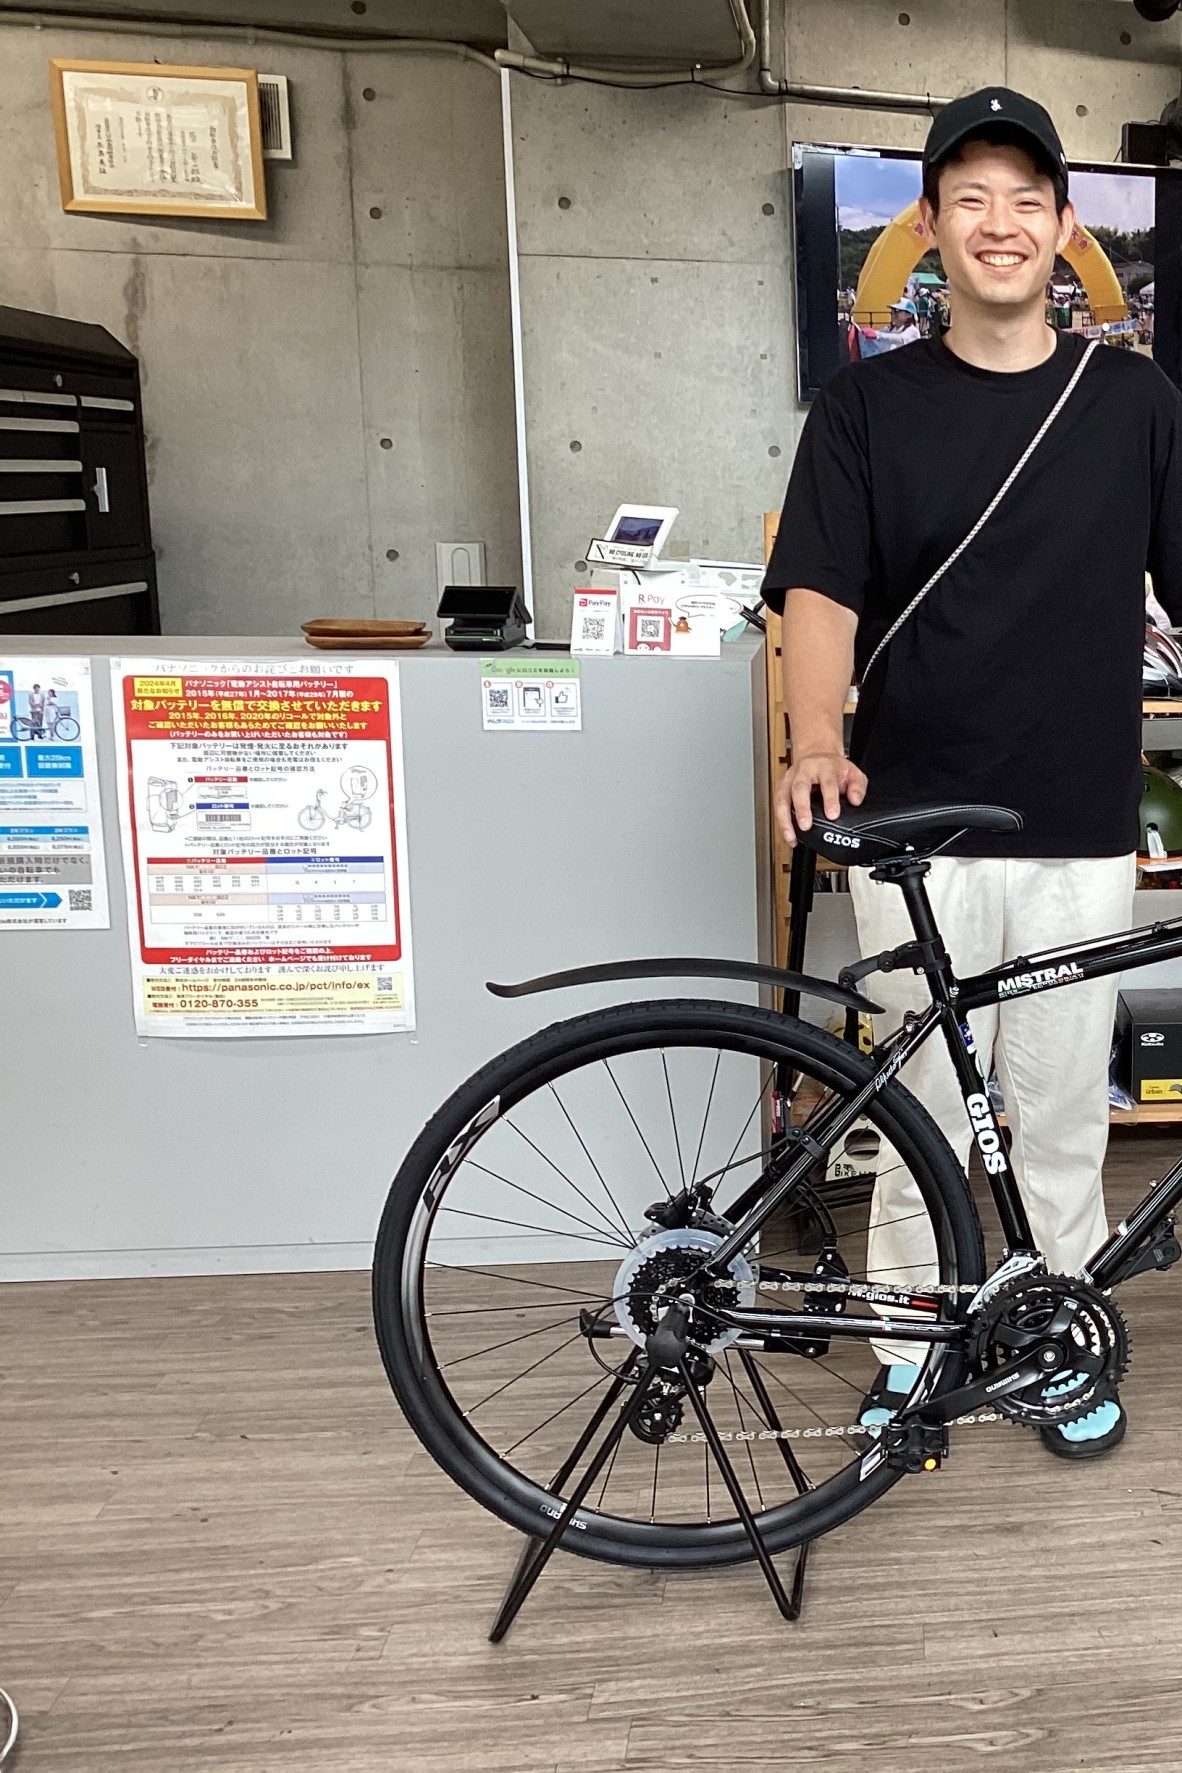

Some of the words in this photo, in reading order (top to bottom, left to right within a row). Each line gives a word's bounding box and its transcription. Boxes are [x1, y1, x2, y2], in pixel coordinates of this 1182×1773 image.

[648, 594, 665, 604] Pay
[823, 832, 860, 848] GIOS
[182, 981, 370, 992] https://panasonic.co.jp/pct/info/ex
[997, 962, 1083, 993] MISTRAL
[180, 999, 258, 1008] 0120-870-355
[967, 1093, 1007, 1174] GIOS
[986, 1372, 1020, 1393] SHIMANO
[540, 1504, 588, 1530] SHIANO
